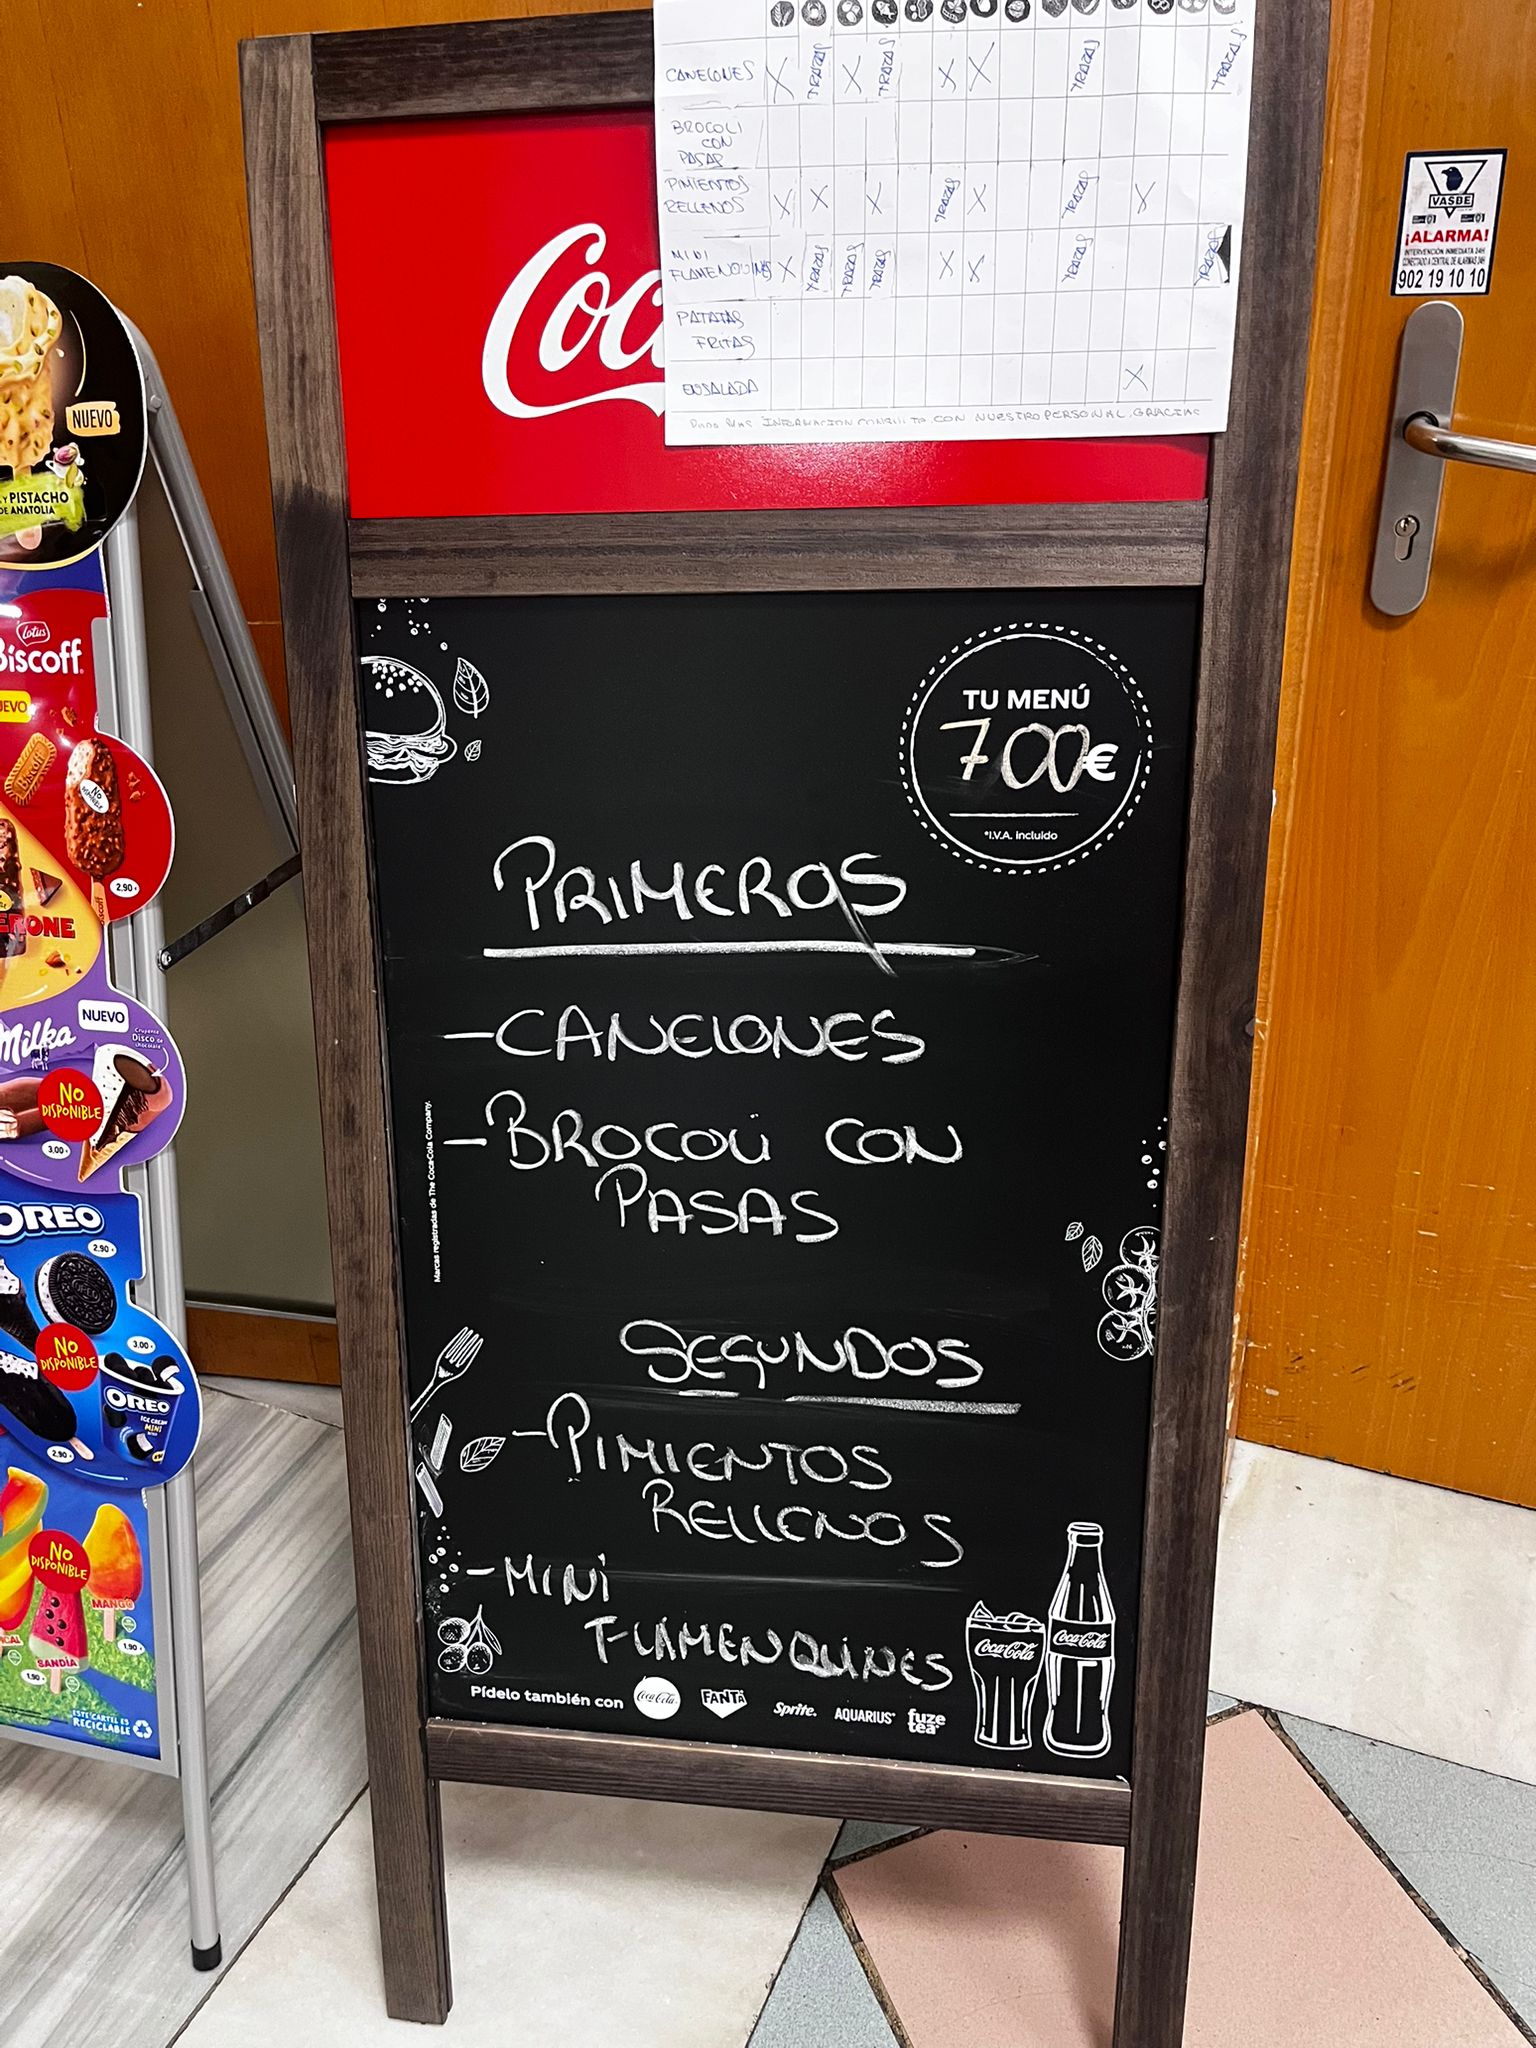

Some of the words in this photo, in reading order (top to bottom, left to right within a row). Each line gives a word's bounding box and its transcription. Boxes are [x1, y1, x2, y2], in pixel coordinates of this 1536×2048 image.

[673, 120, 742, 135] BROCOLI
[701, 136, 732, 149] CON
[665, 175, 750, 193] PIMIENTOS
[664, 197, 744, 214] RELLENOS
[1432, 196, 1471, 205] VASDE
[1405, 229, 1489, 246] ¡ALARMA!
[1398, 269, 1423, 288] 902
[1429, 268, 1444, 288] 19
[1449, 268, 1465, 288] 10
[1470, 267, 1486, 287] 10
[676, 310, 745, 329] PATATAS
[72, 409, 113, 429] NUEVO
[934, 413, 966, 423] CON
[975, 411, 1041, 422] NUESTRO
[9, 491, 69, 504] PISTACHO
[10, 505, 55, 515] ANATOLIA
[22, 625, 46, 640] Lotus
[963, 690, 999, 709] TU
[1007, 683, 1090, 710] MENÚ
[17, 752, 45, 791] Biscoff
[1015, 830, 1058, 840] incluido
[494, 835, 907, 931] PRIMEROS
[82, 1009, 125, 1024] NUEVO
[0, 1017, 77, 1065] Milka
[132, 1033, 155, 1043] Disco
[495, 1004, 926, 1064] CANELONES
[42, 1103, 102, 1120] DISPONIBLE
[825, 1118, 963, 1165] CON
[426, 1141, 435, 1181] Coca-Cola
[430, 1198, 437, 1209] de
[596, 1163, 839, 1243] PASAS
[0, 1204, 101, 1236] OREO
[431, 1210, 440, 1254] registradas
[619, 1318, 986, 1389] SEGUNDOS
[40, 1356, 98, 1371] DISPONIBLE
[106, 1388, 170, 1413] OREO
[547, 1392, 893, 1490] PIMIENTOS
[642, 1480, 964, 1568] RELLENOS
[31, 1555, 88, 1580] DISPONIBLE
[92, 1599, 133, 1609] MANGO
[1053, 1629, 1111, 1650] Coca-Cola
[974, 1638, 1039, 1661] Coca-Cola
[37, 1656, 78, 1668] SANDÍA
[470, 1685, 521, 1701] Pídelo
[524, 1689, 590, 1707] también
[594, 1697, 624, 1710] con
[72, 1709, 91, 1719] ESTE
[91, 1713, 118, 1724] CARTEL
[120, 1718, 129, 1726] ES
[834, 1707, 893, 1725] AQUARIUS
[908, 1708, 946, 1726] fuze
[72, 1717, 131, 1736] RECICLABLE
[908, 1722, 939, 1735] tea
